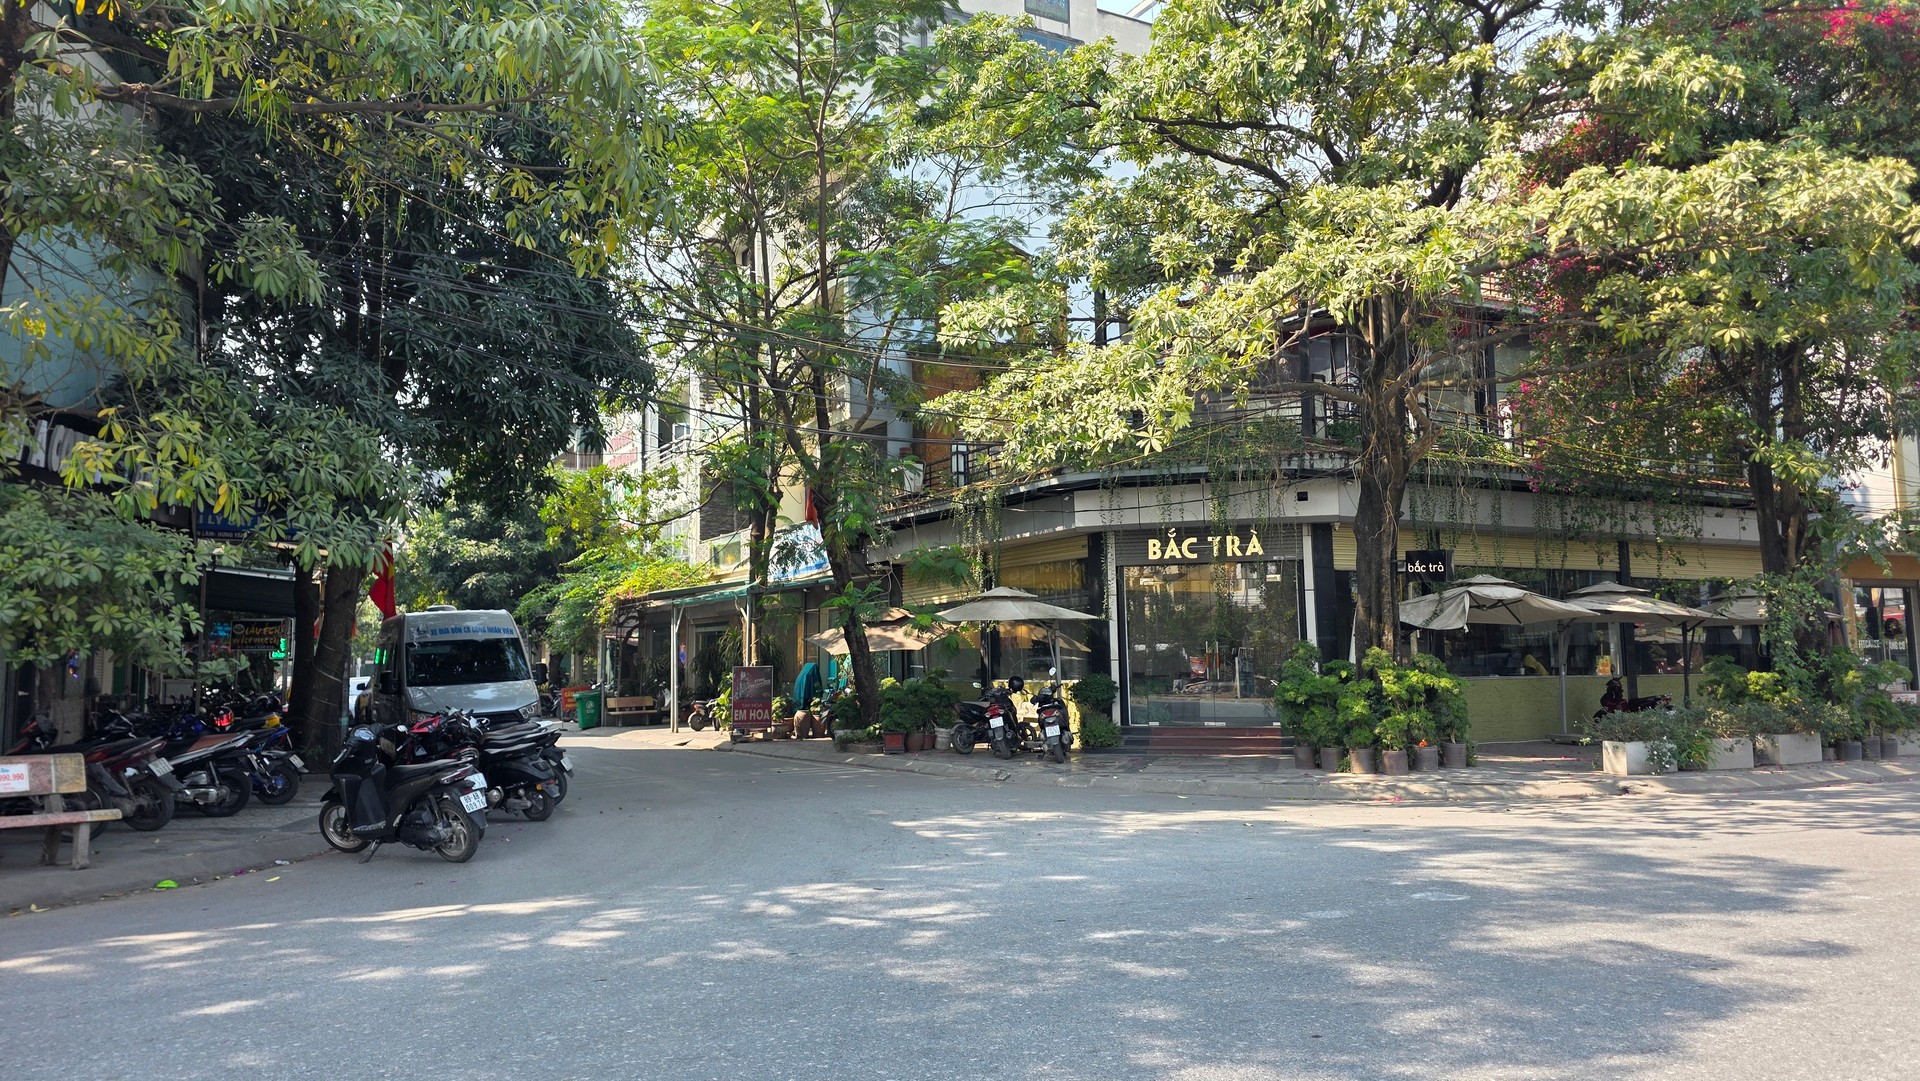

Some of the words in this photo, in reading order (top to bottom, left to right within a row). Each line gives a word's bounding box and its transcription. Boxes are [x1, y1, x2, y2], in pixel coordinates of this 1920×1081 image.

[1148, 528, 1198, 560] BẮC
[1207, 529, 1265, 557] TRÀ
[1407, 560, 1427, 573] bắc
[1428, 561, 1444, 573] trà
[734, 709, 747, 720] EM
[749, 709, 770, 720] HOA
